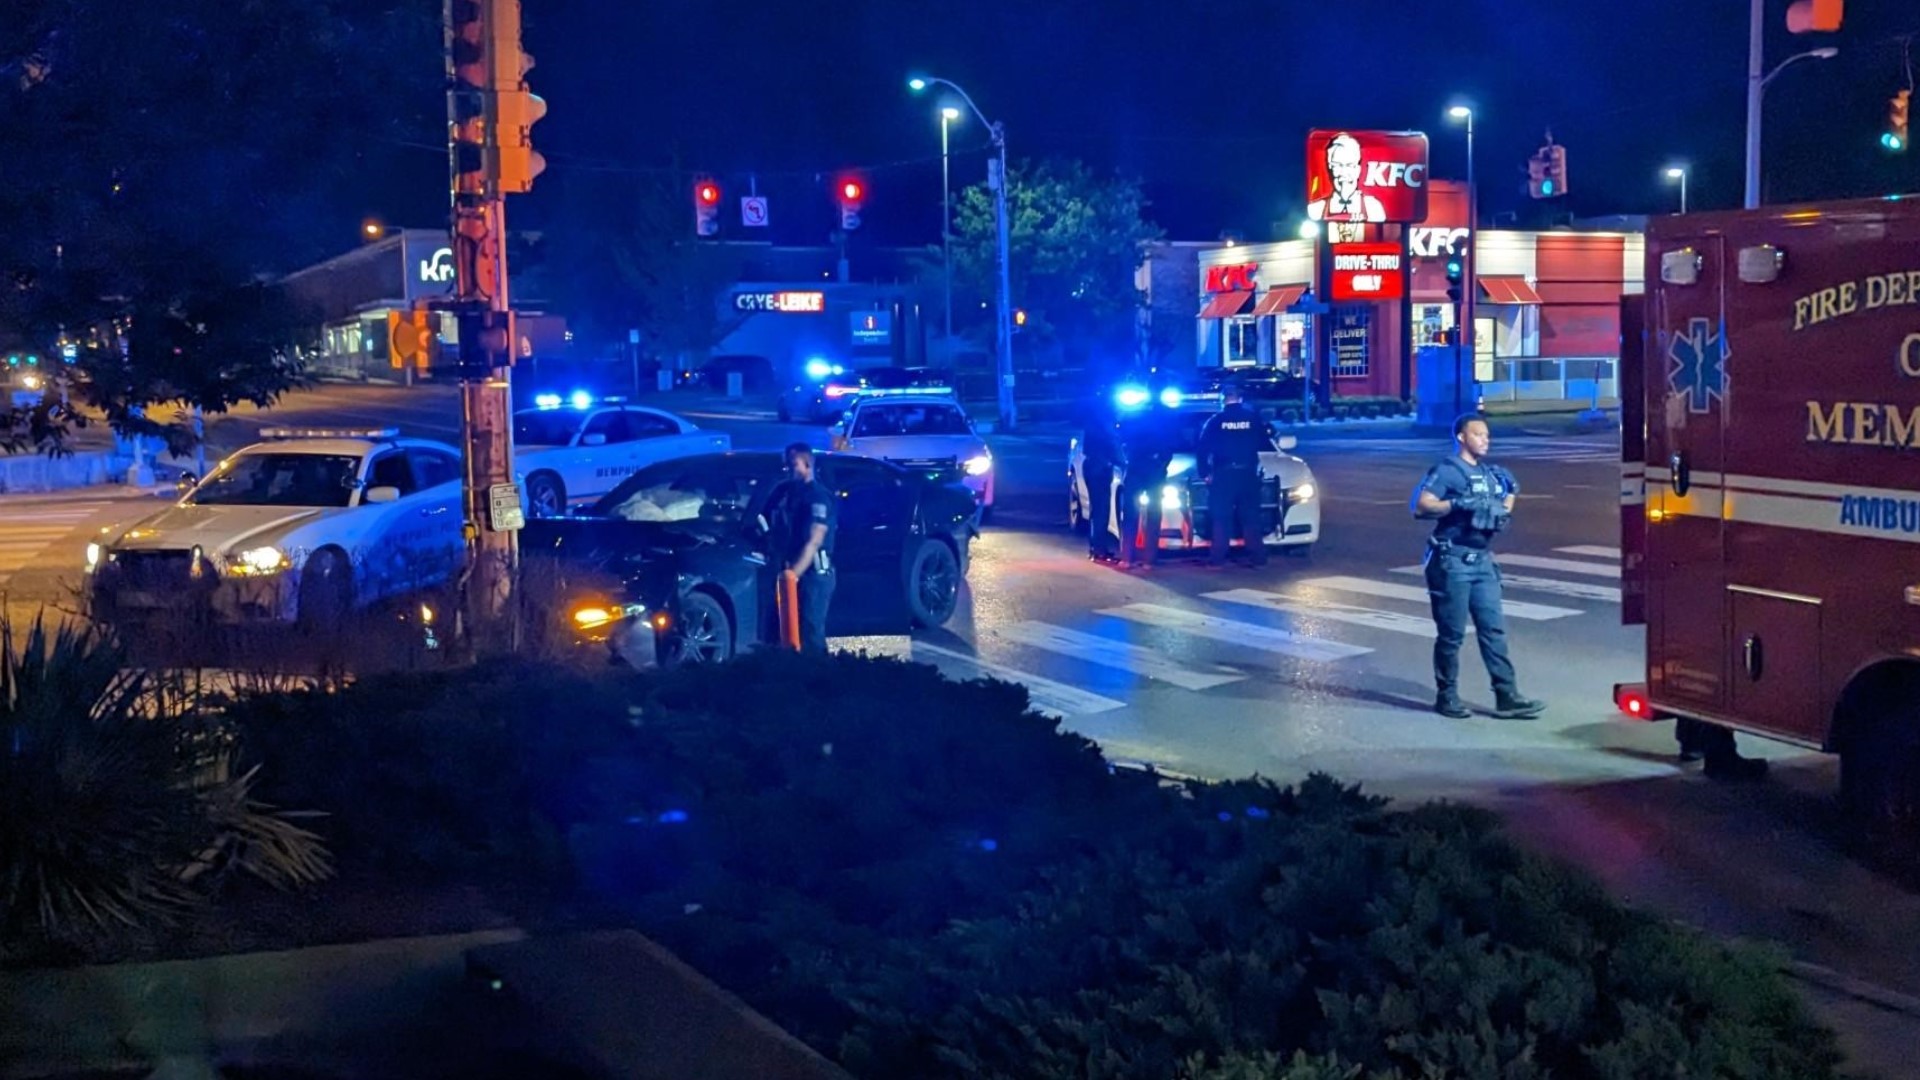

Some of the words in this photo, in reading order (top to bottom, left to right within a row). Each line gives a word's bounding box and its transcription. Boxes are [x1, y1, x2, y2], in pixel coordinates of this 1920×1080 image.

[1363, 161, 1425, 188] KFC
[1409, 227, 1470, 256] KFC
[1206, 262, 1258, 293] KFC
[1335, 255, 1400, 270] DRIVE-THRU
[1793, 281, 1857, 330] FIRE
[1806, 401, 1920, 447] MEM
[1840, 494, 1920, 533] AMBU
